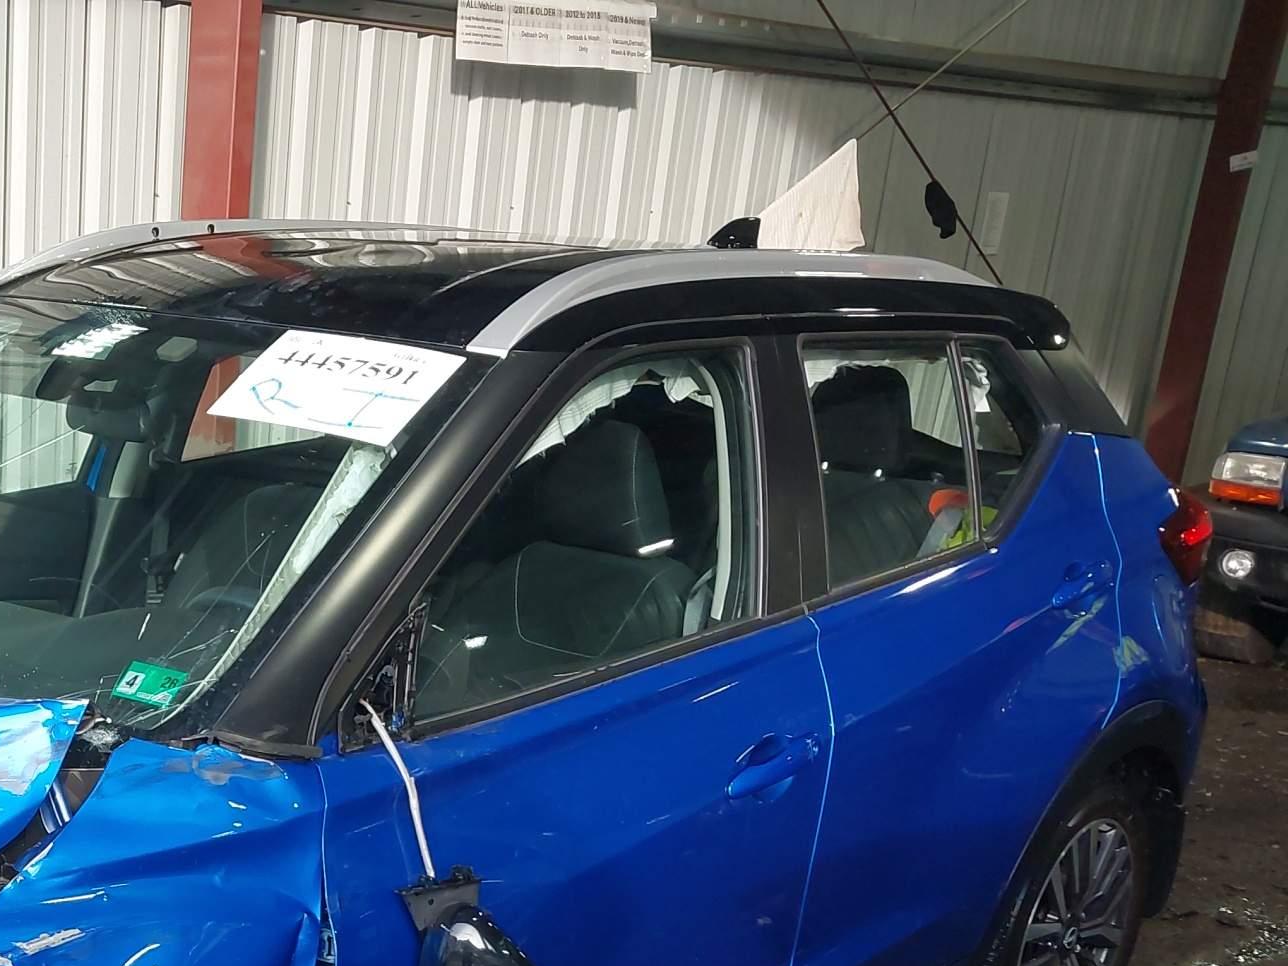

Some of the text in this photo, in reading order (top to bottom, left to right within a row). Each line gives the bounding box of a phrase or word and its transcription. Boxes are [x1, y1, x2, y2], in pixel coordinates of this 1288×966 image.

[535, 8, 556, 17] OLDER
[278, 350, 420, 385] 44457591
[125, 675, 138, 688] 4
